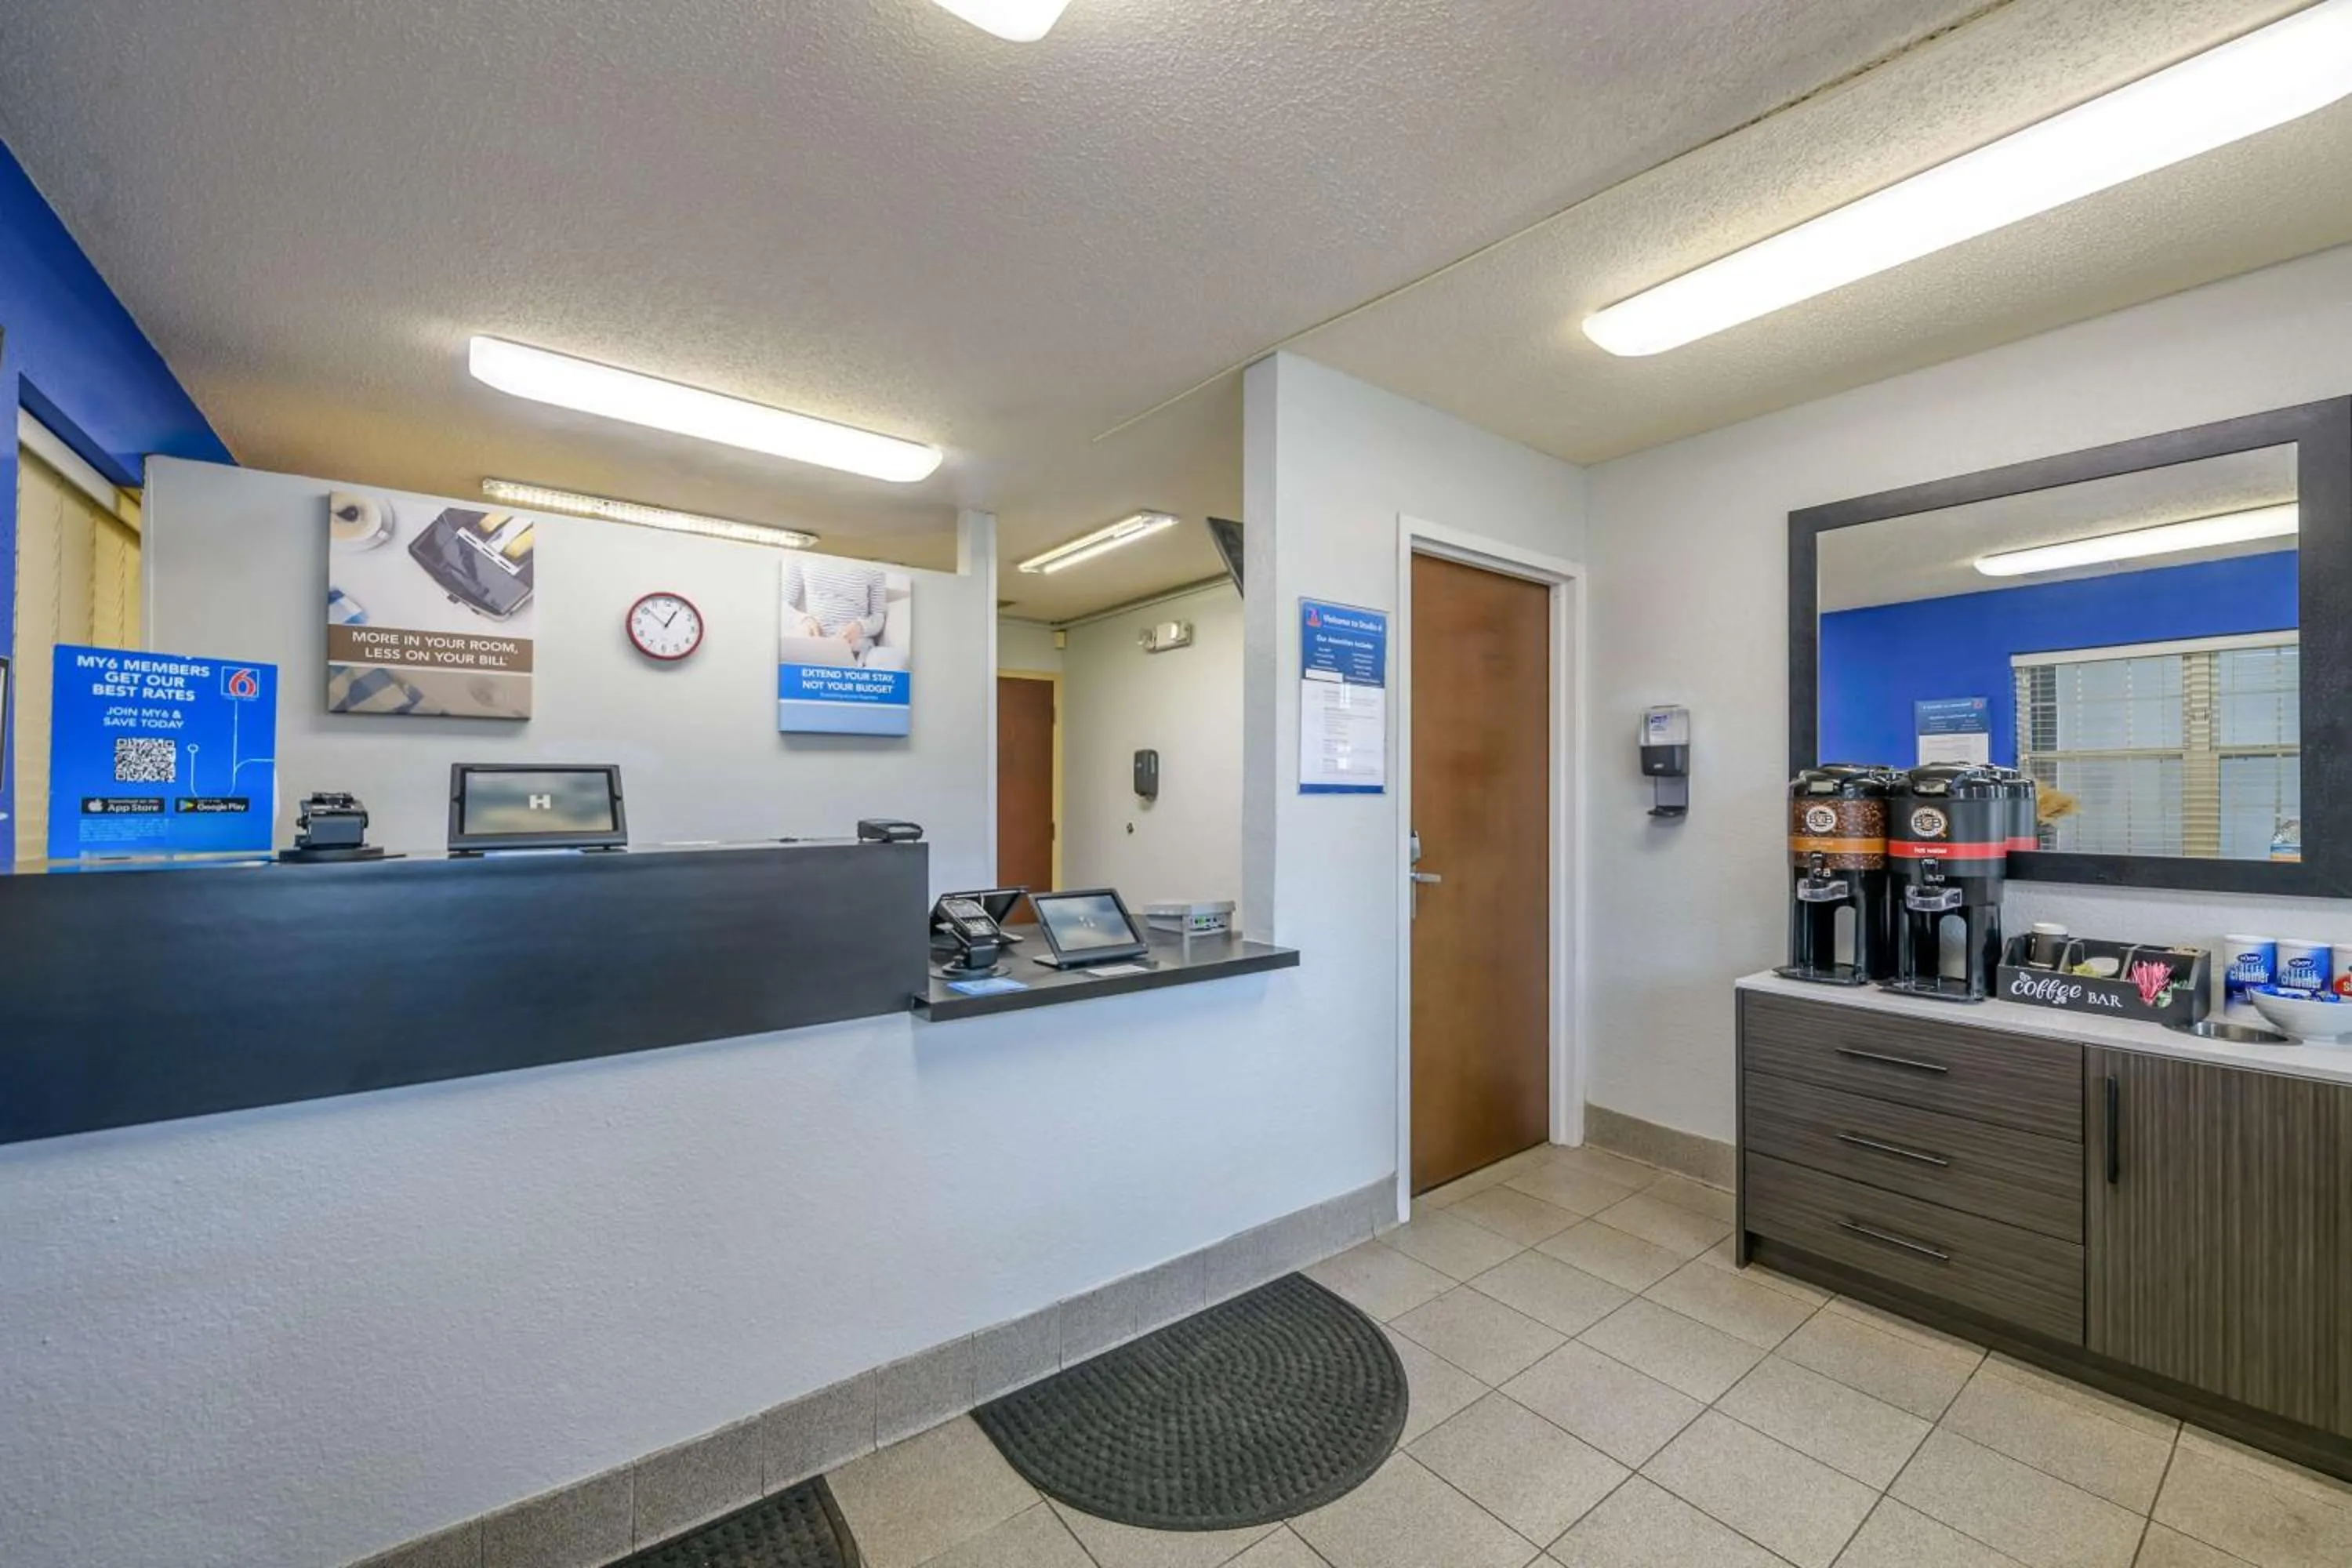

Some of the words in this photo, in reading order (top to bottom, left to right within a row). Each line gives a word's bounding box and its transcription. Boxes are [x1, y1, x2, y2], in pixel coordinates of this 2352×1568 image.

[352, 631, 399, 644] MORE
[404, 635, 419, 647] IN
[426, 637, 465, 649] YOUR
[470, 641, 518, 655] ROOM,
[365, 647, 401, 659] LESS
[405, 649, 430, 661] ON
[434, 652, 474, 664] YOUR
[479, 655, 507, 666] BILL
[77, 655, 118, 670] MY6
[123, 659, 211, 677] MEMBERS
[104, 671, 141, 684] GET
[146, 674, 185, 688] OUR
[229, 668, 256, 697] 6
[802, 668, 841, 679] EXTEND
[844, 671, 870, 681] YOUR
[871, 673, 895, 684] STAY,
[93, 684, 138, 698] BEST
[142, 687, 195, 702] RATES
[802, 680, 824, 690] NOT
[827, 681, 854, 691] YOUR
[855, 684, 894, 694] BUDGET
[106, 706, 138, 717] JOIN
[142, 708, 169, 719] MY6
[172, 709, 181, 720] &
[103, 717, 136, 728] SAVE
[141, 718, 185, 729] TODAY
[107, 803, 130, 815] App
[131, 804, 160, 812] Store
[197, 803, 227, 813] Google
[228, 802, 246, 813] Play
[2010, 978, 2083, 1000] coffee
[2087, 991, 2124, 1008] BAR
